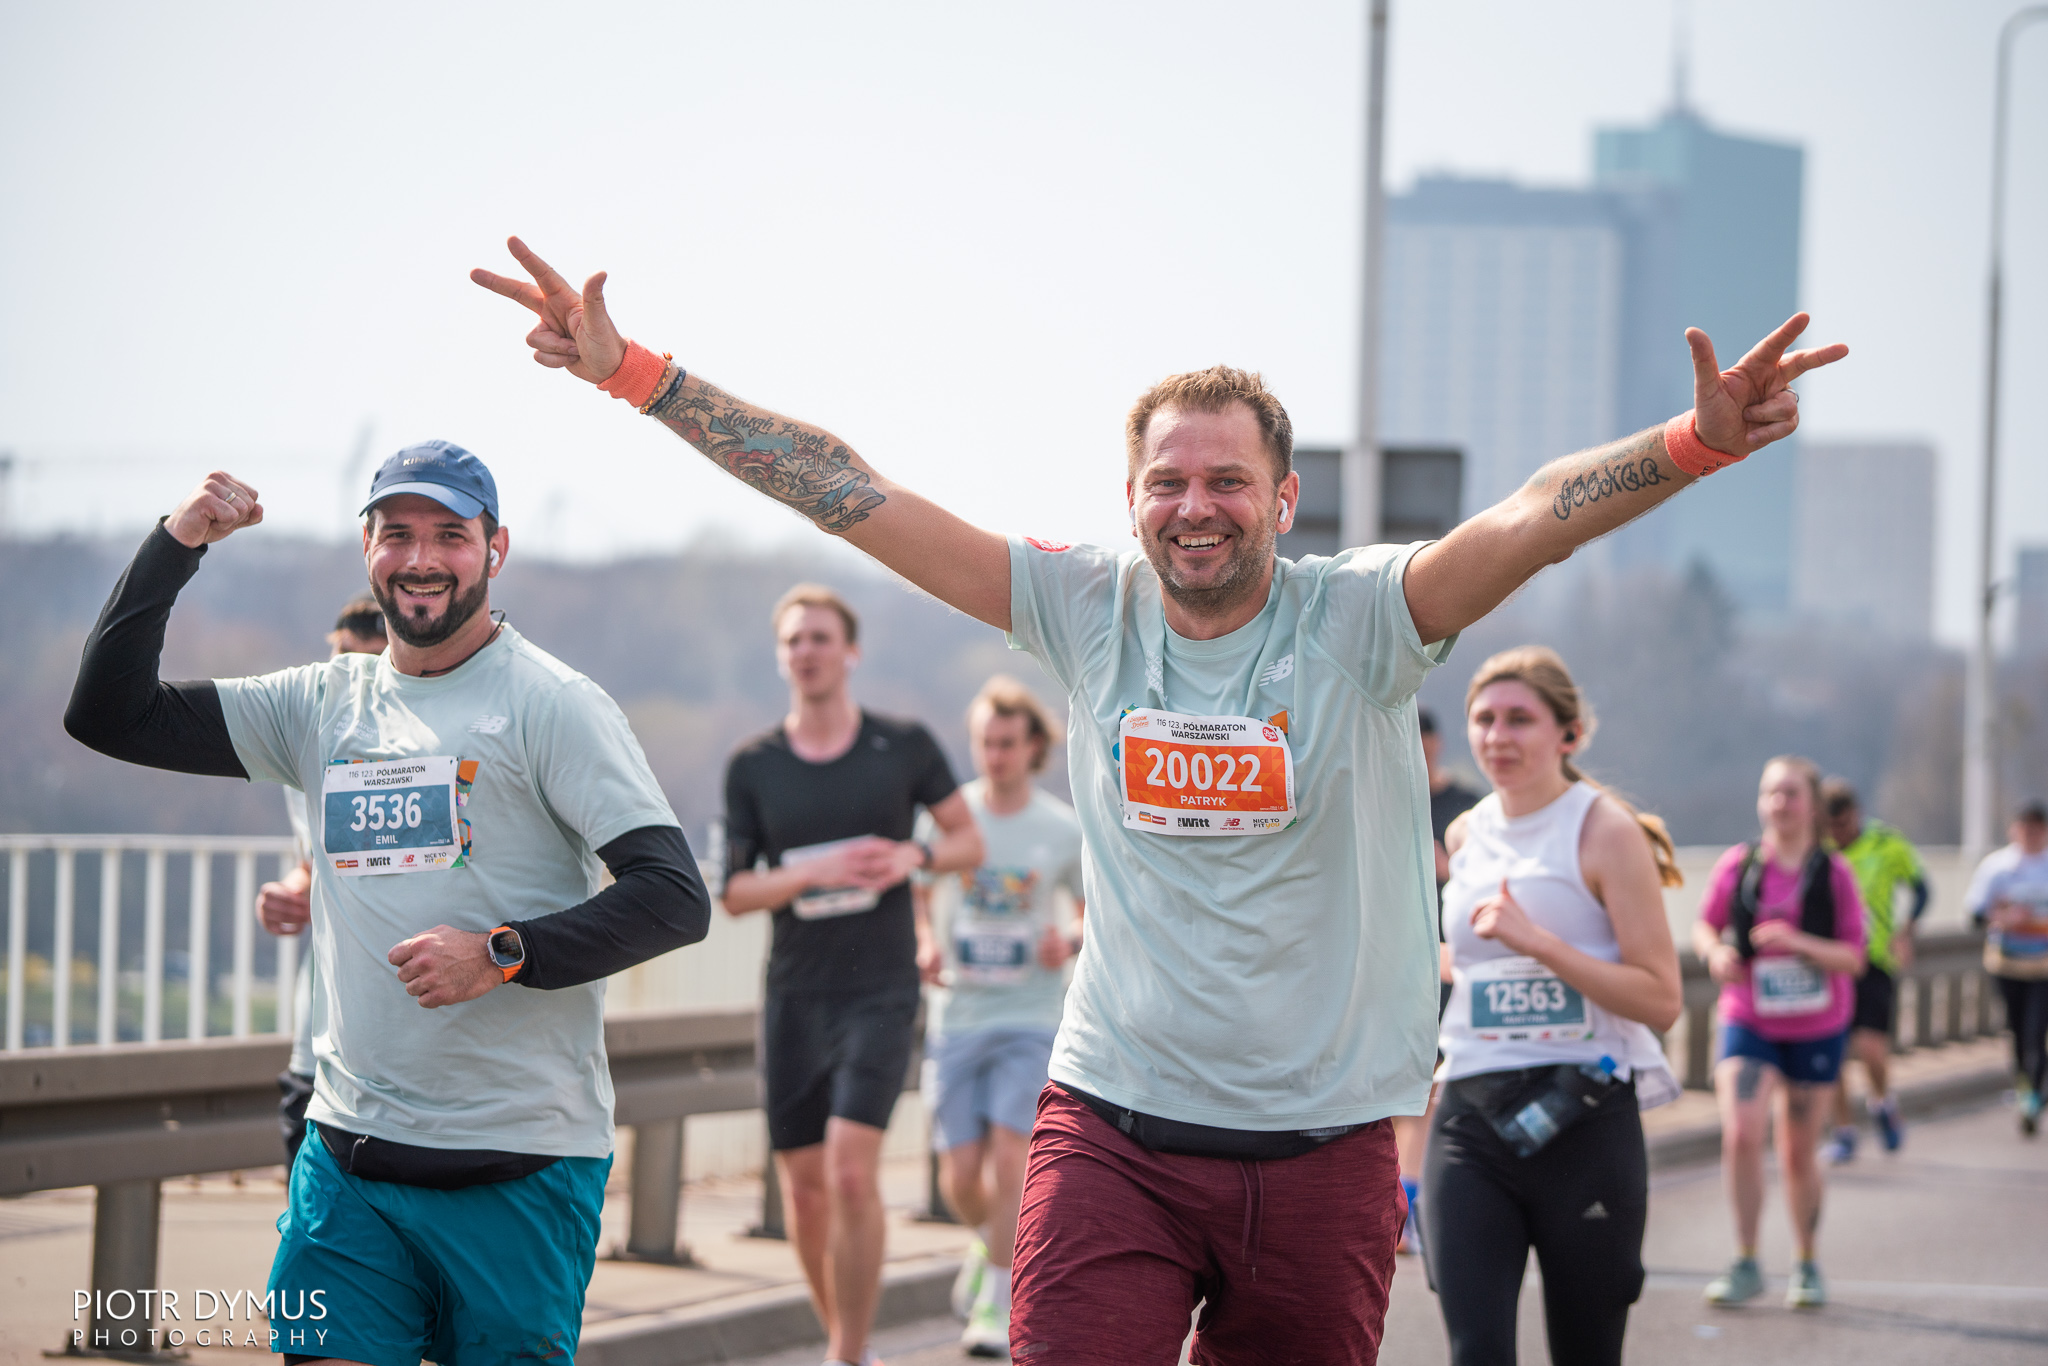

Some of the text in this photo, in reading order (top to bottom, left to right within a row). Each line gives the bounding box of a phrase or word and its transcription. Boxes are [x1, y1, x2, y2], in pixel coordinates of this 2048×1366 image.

[724, 408, 774, 437] Tough
[778, 422, 829, 452] People
[1156, 718, 1246, 732] 116 123. PÓŁMARATON
[1171, 730, 1230, 741] WARSZAWSKI
[376, 765, 426, 777] PÓŁMARATON
[1144, 747, 1262, 793] 20022
[364, 776, 413, 787] WARSZAWSKI
[1180, 795, 1227, 807] PATRYK
[350, 791, 422, 832] 3536
[375, 834, 399, 845] EMIL
[1484, 980, 1567, 1013] 12563
